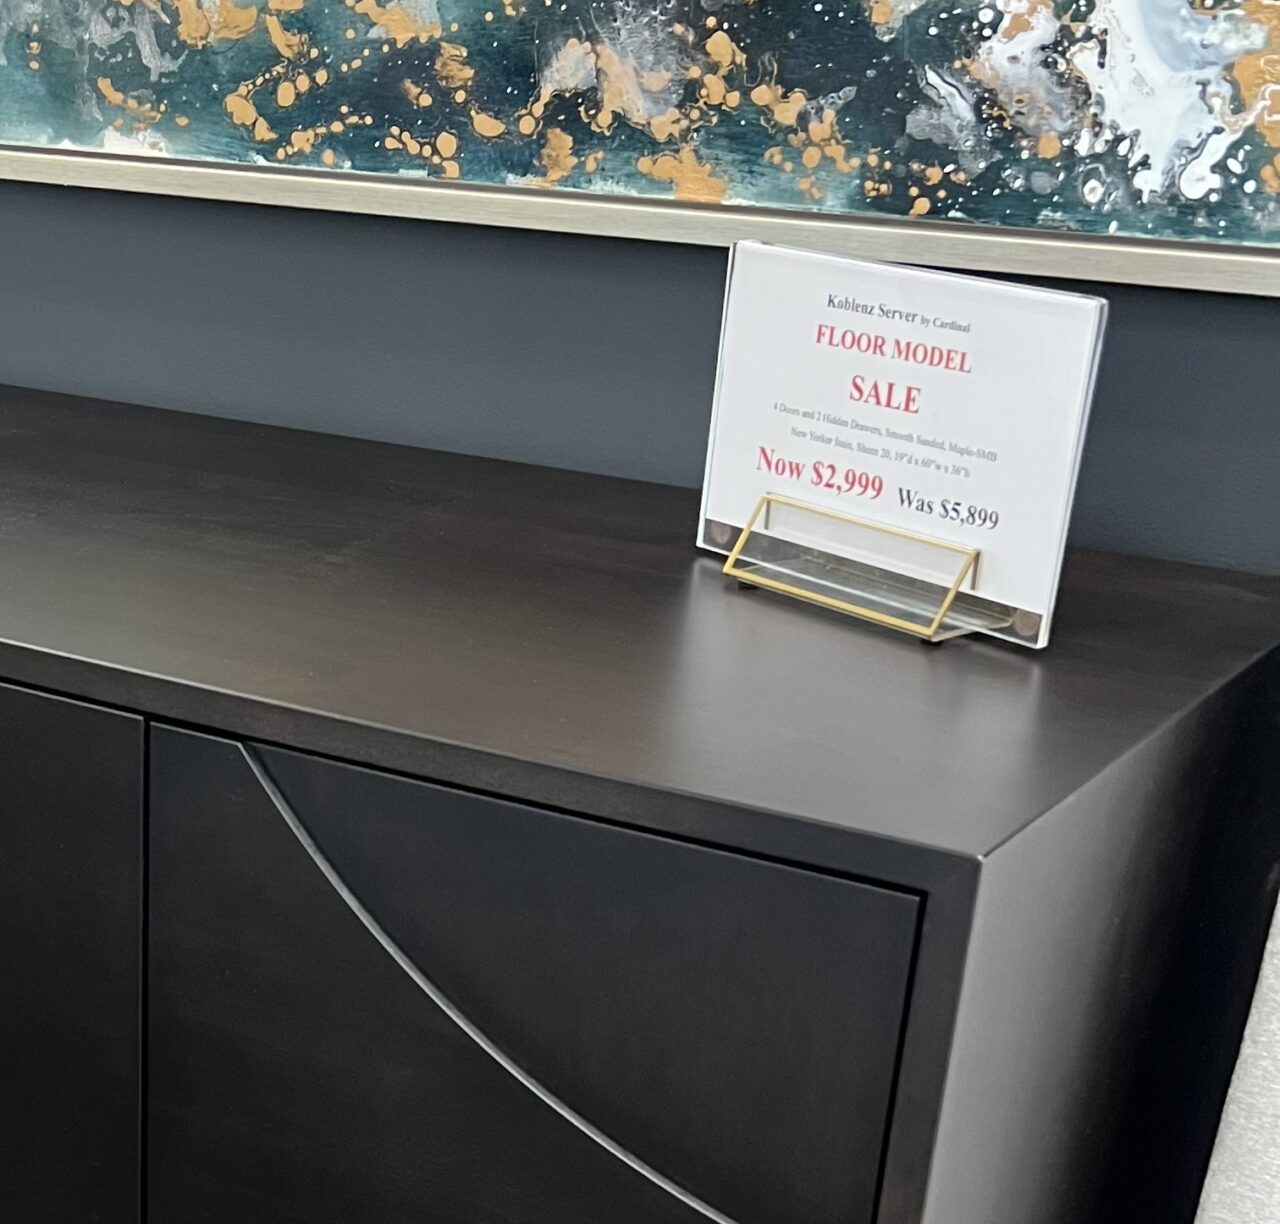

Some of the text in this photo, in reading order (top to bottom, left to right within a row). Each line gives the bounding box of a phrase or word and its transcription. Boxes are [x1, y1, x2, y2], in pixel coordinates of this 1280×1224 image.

[827, 294, 971, 334] Koblenz Server by Cardinal
[815, 323, 972, 374] FLOOR MODEL
[779, 402, 800, 416] Doors
[801, 410, 815, 420] and
[849, 374, 923, 414] SALE
[757, 446, 1000, 530] Now $2,999 Was $5,899
